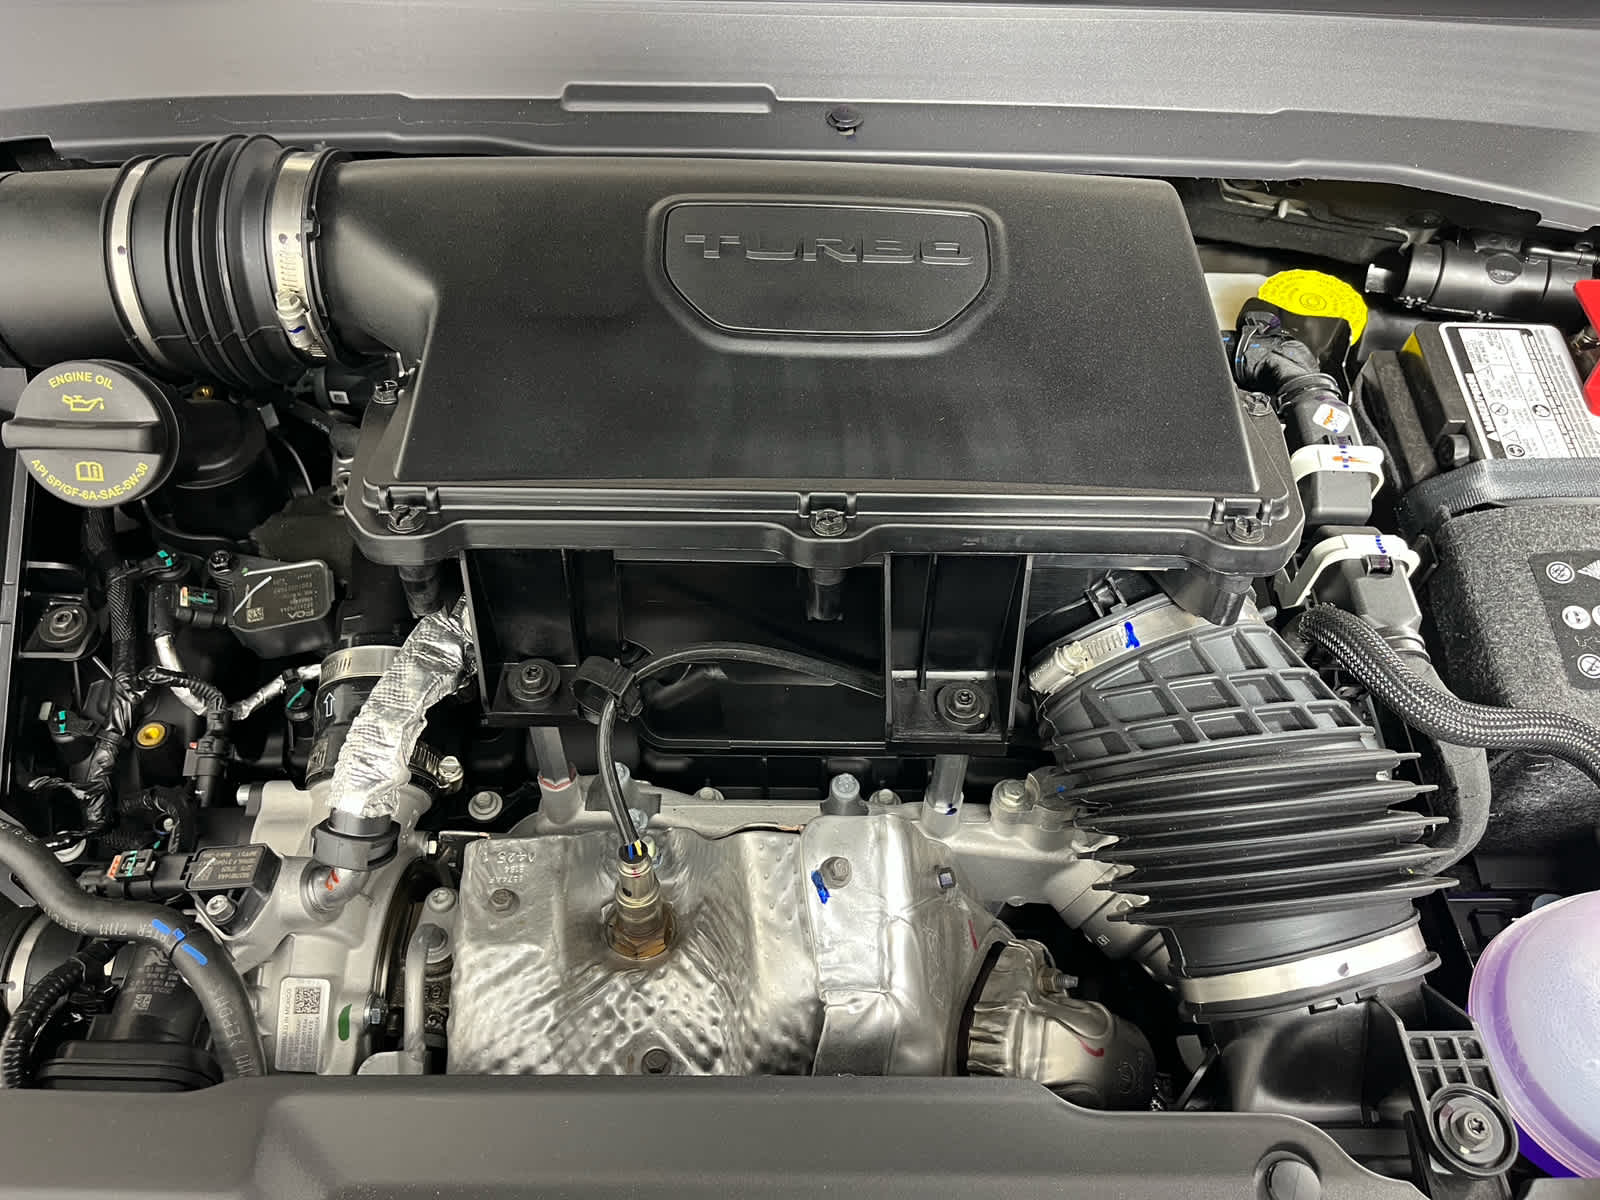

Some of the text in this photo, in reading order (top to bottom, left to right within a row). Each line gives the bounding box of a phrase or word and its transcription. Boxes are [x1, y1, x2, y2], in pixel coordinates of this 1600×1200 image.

[684, 234, 974, 266] TURBO
[48, 371, 113, 390] ENGINE OIL
[31, 459, 49, 478] API
